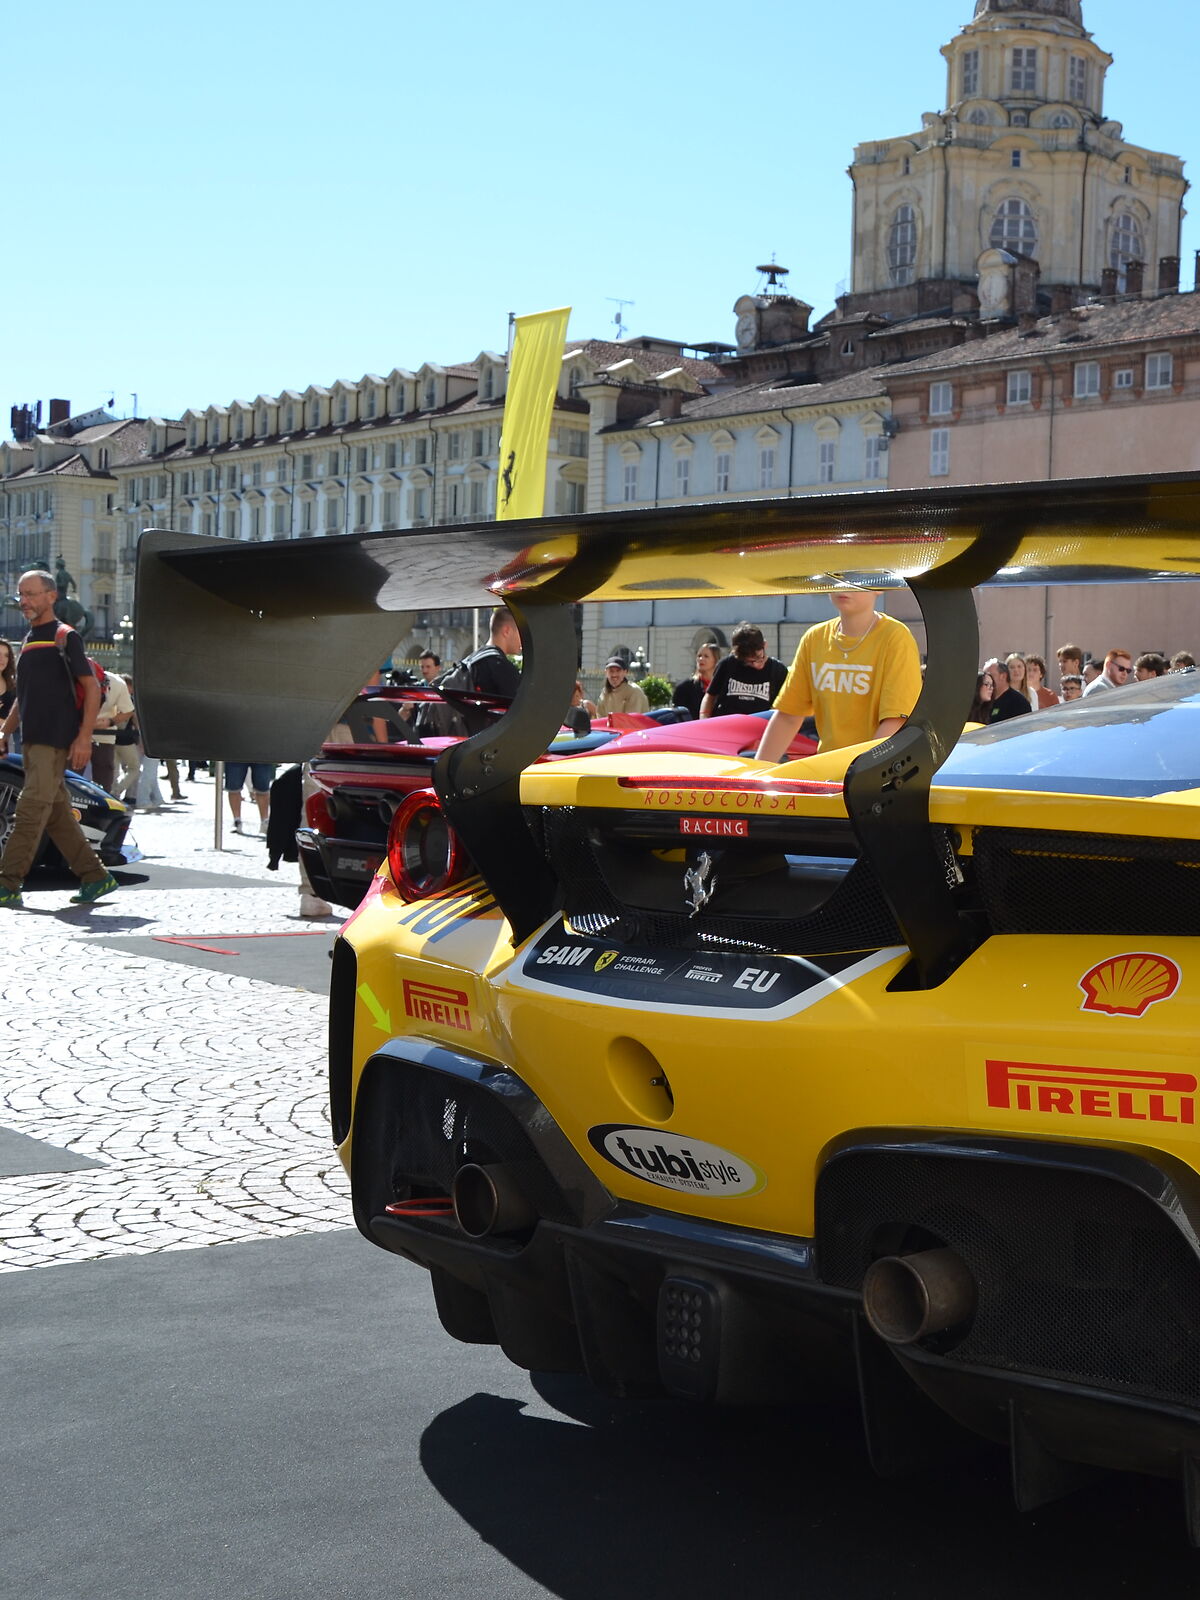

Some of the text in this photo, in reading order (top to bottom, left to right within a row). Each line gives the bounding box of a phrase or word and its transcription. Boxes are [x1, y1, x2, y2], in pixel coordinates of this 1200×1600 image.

[727, 678, 769, 700] LONSDALE
[811, 662, 873, 695] VANS
[644, 790, 797, 810] ROSSOCORSA
[683, 819, 744, 835] RACING
[536, 945, 594, 967] SAM
[619, 955, 657, 966] FERRARI
[613, 963, 665, 976] CHALLENGE
[684, 969, 724, 984] PIRELLI
[732, 967, 782, 993] EU
[402, 979, 473, 1032] PIRELLI
[985, 1059, 1198, 1125] PIRELLI
[646, 1171, 710, 1191] EXHAUST SYSTEMS
